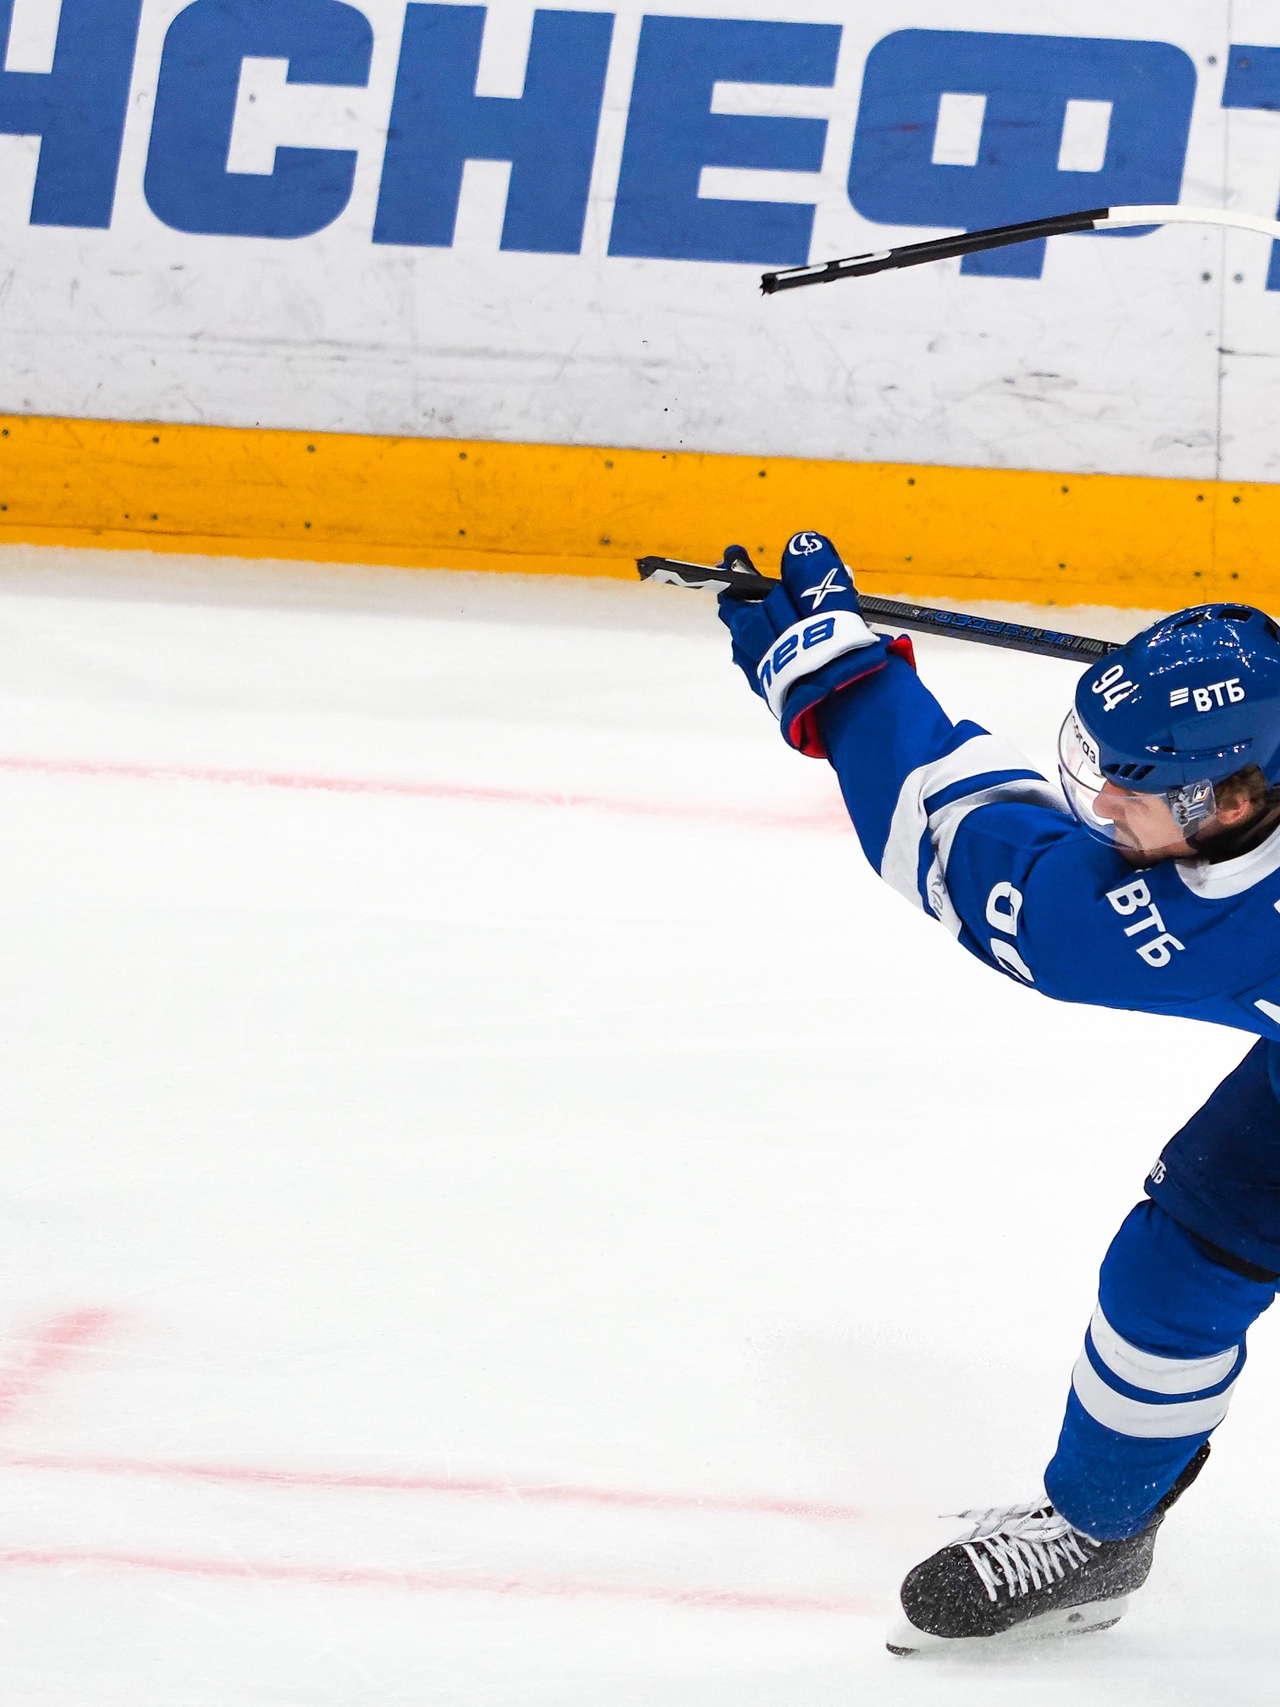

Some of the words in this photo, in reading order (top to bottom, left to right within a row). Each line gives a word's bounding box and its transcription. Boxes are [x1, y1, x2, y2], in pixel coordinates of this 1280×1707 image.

[1091, 664, 1139, 712] 94
[1192, 677, 1246, 713] ВТБ
[1105, 878, 1186, 968] ВТБ
